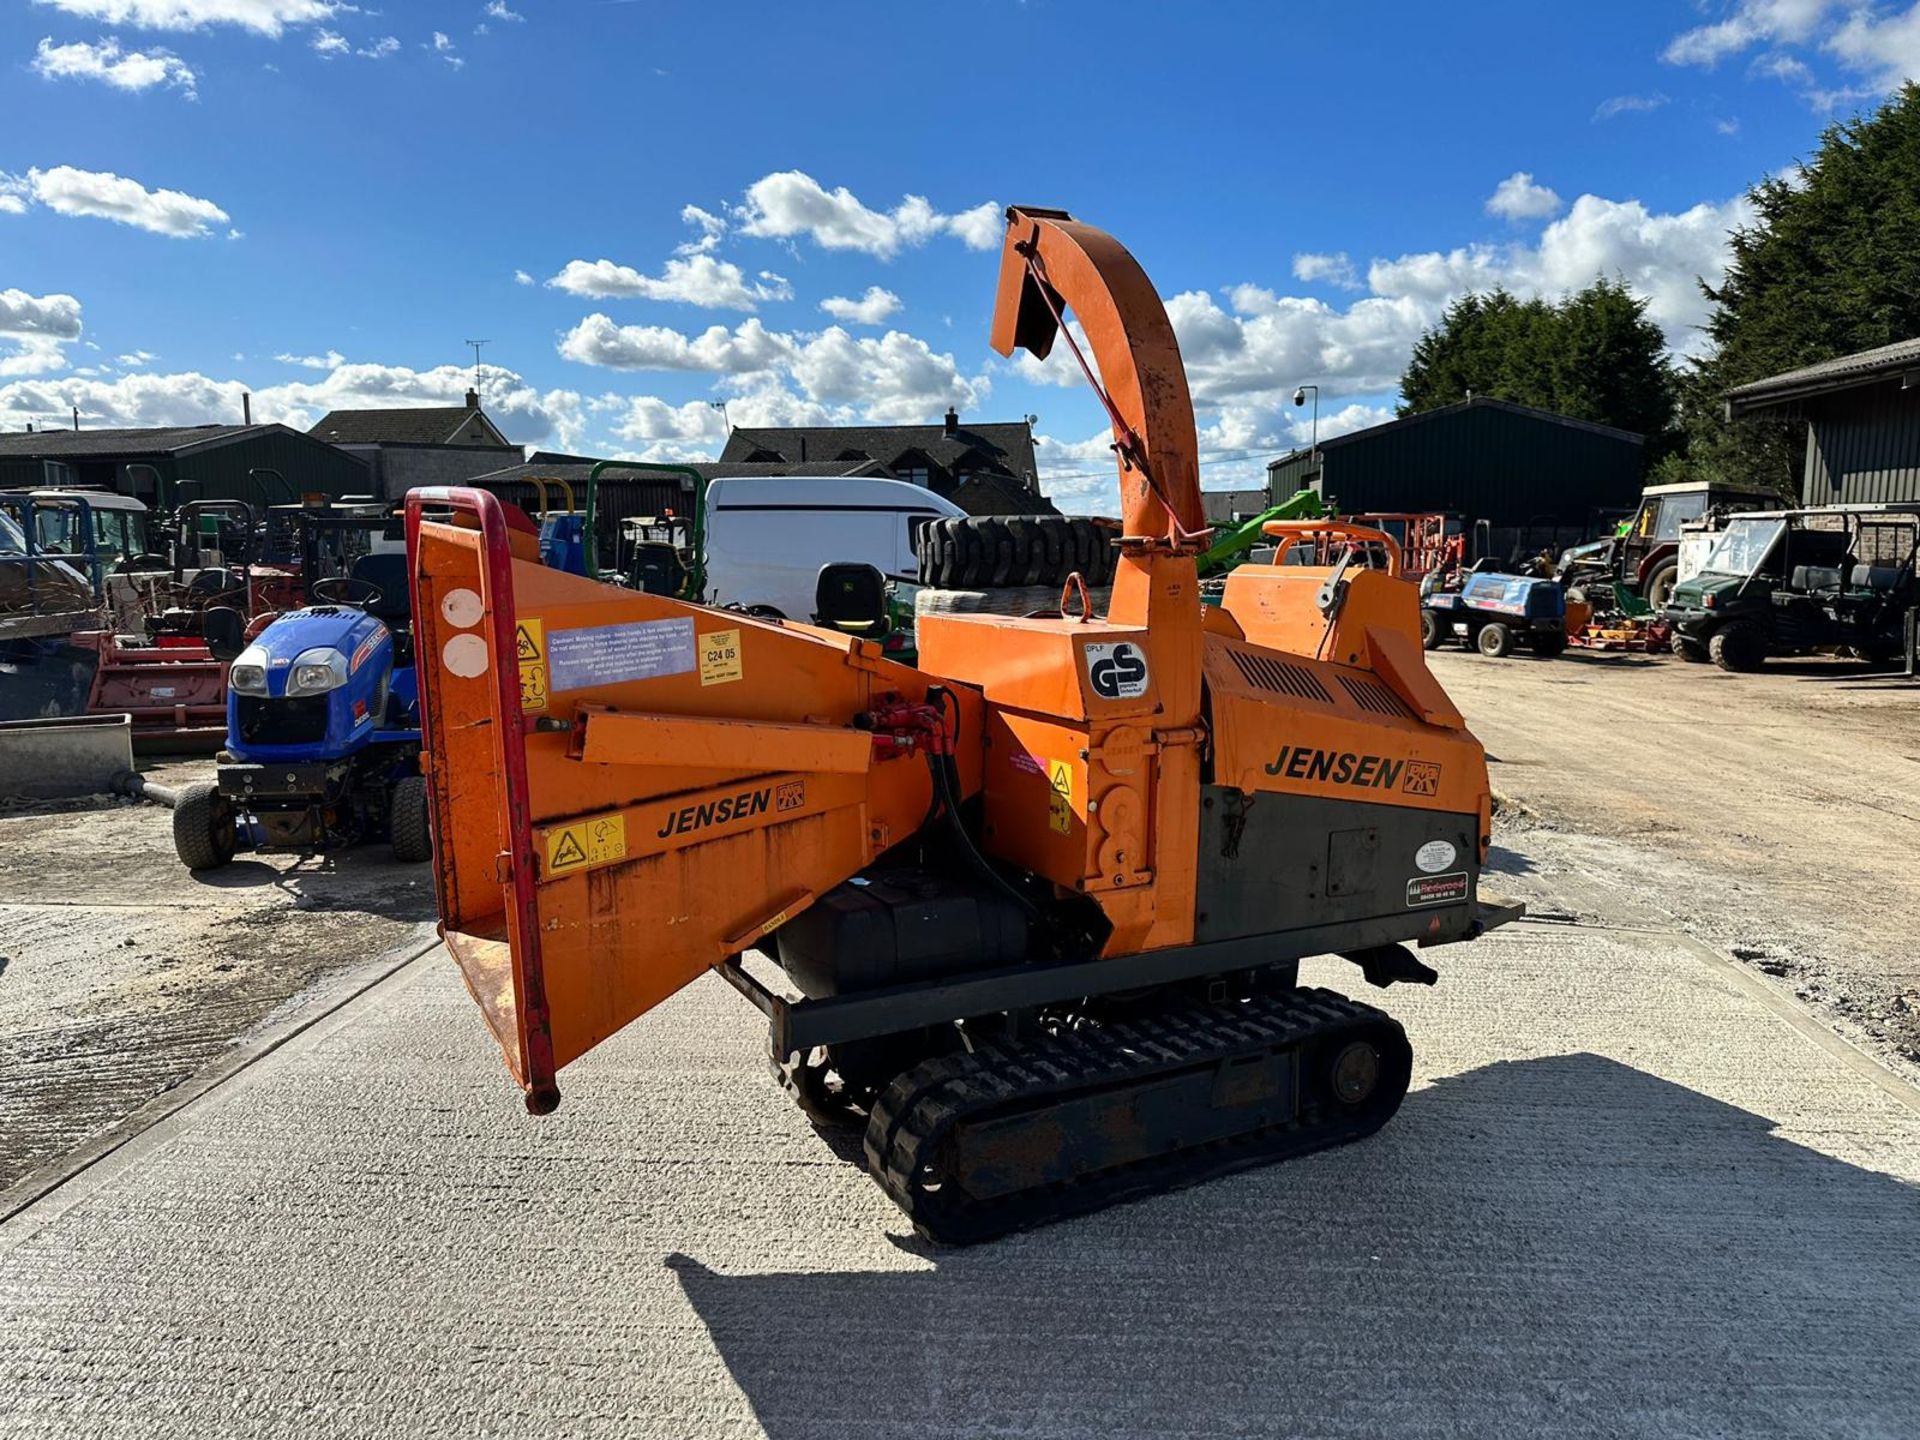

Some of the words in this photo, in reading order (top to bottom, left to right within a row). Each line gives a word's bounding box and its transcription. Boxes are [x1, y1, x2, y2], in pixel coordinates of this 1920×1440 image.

[707, 650, 722, 662] C24
[725, 648, 735, 659] 05
[1265, 745, 1405, 789] JENSEN
[657, 788, 772, 838] JENSEN
